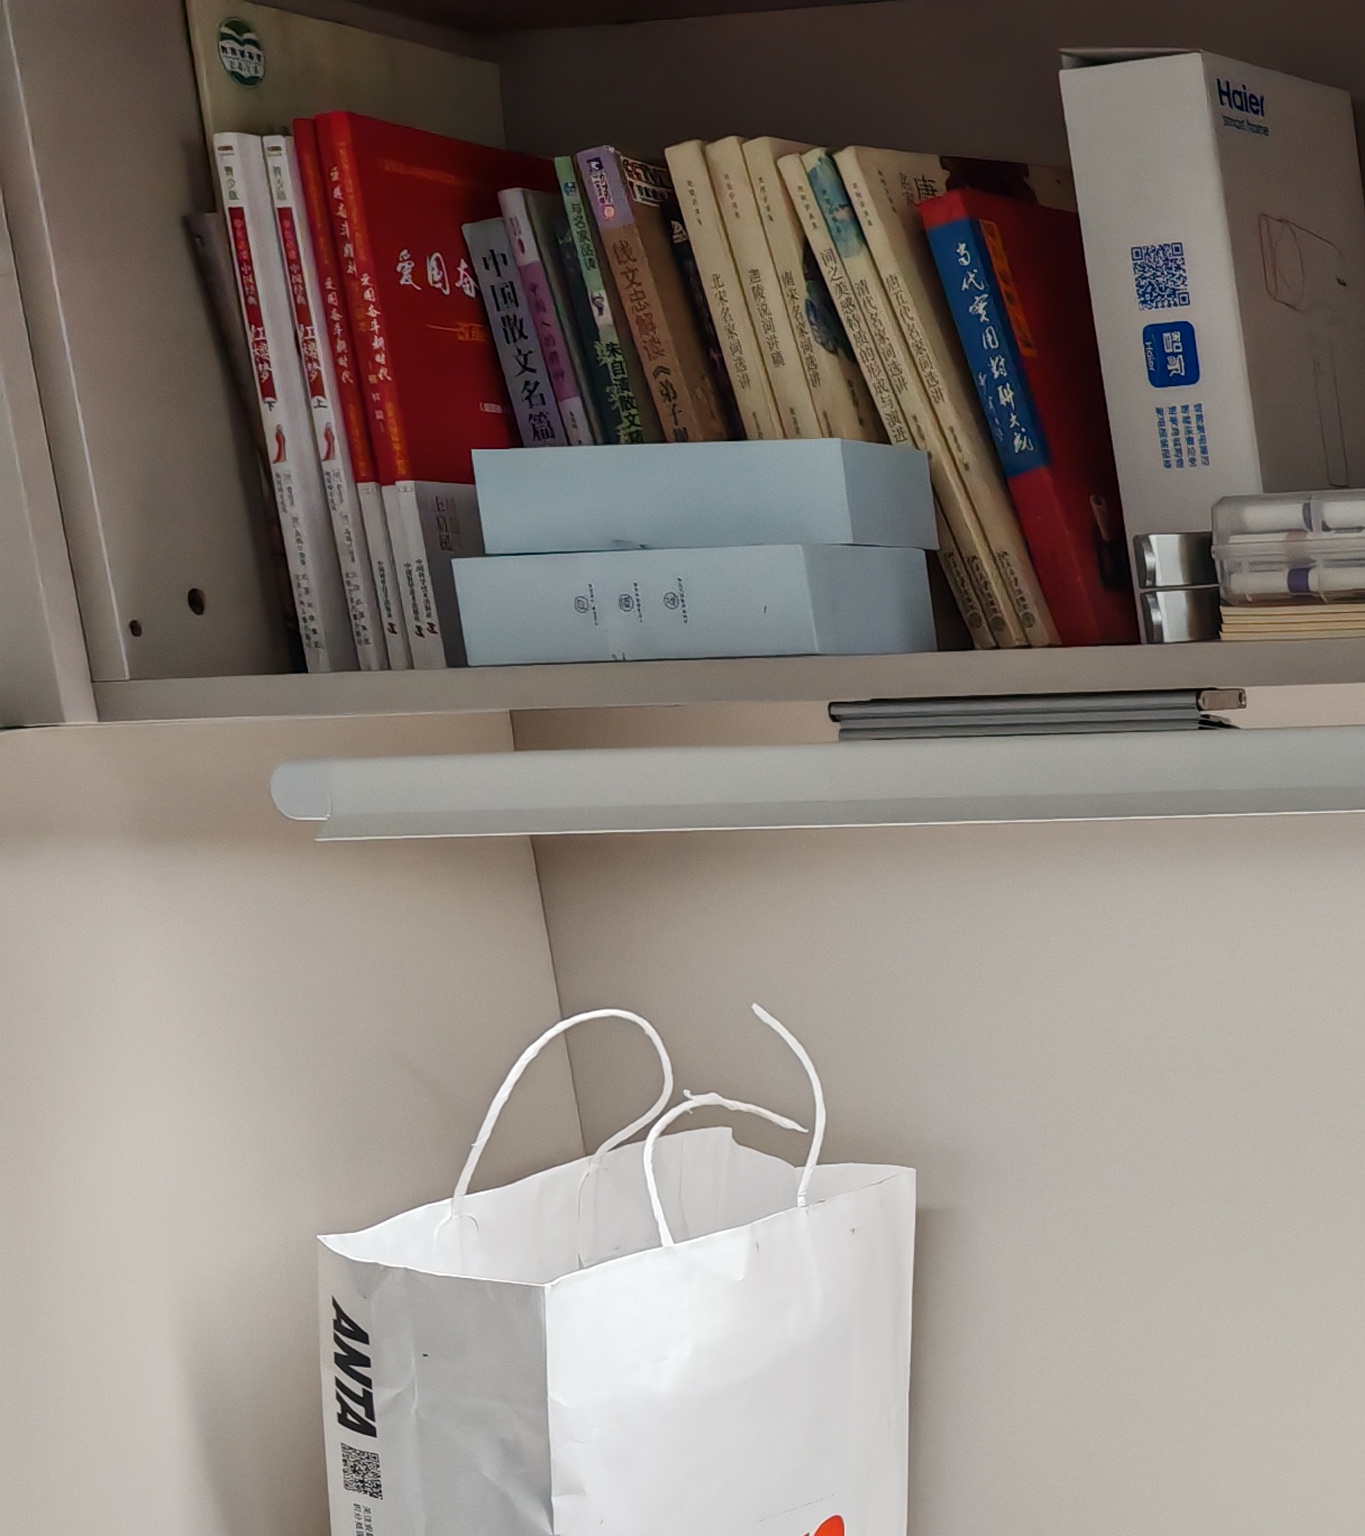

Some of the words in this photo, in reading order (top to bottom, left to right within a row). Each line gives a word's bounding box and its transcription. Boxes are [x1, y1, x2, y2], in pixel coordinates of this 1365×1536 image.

[1216, 78, 1265, 117] Haier
[483, 249, 556, 442] 中国散文名篇
[1144, 341, 1156, 372] Haier
[333, 1295, 378, 1438] ANTA
